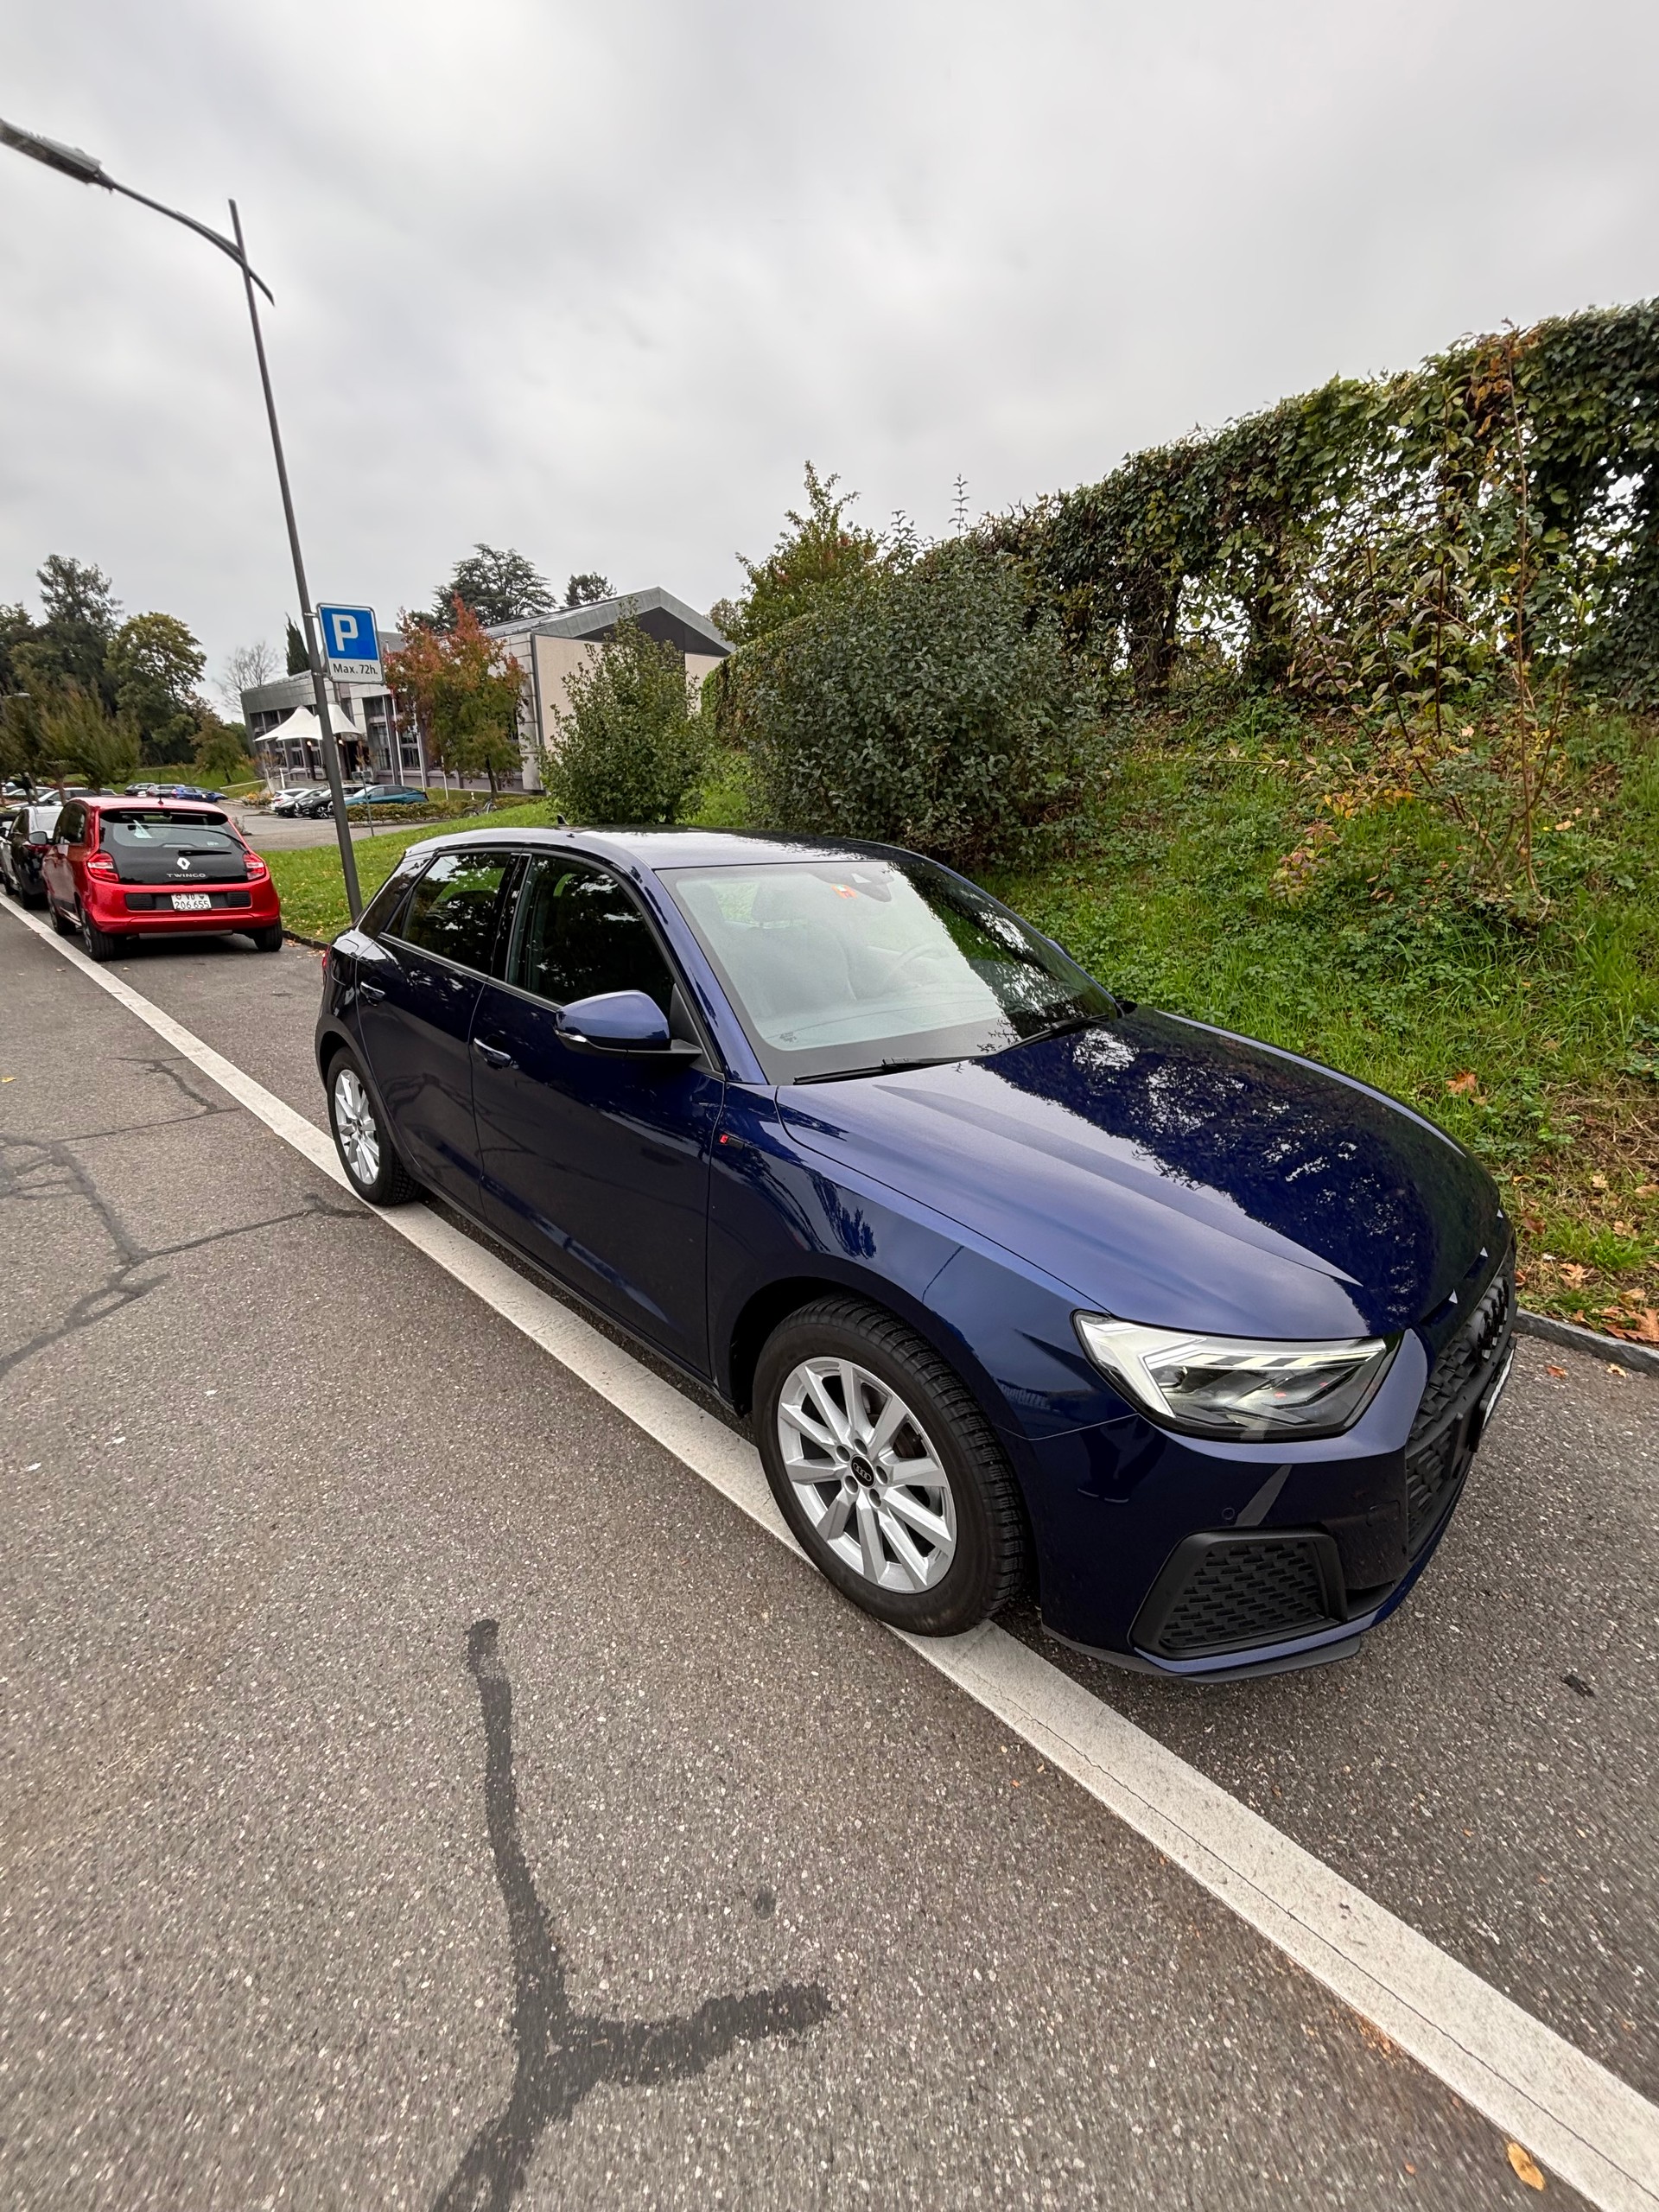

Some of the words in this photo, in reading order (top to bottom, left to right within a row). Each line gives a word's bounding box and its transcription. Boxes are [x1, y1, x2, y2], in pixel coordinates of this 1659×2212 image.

[331, 613, 359, 652] P
[333, 663, 359, 674] Max.
[359, 664, 378, 675] 72h.
